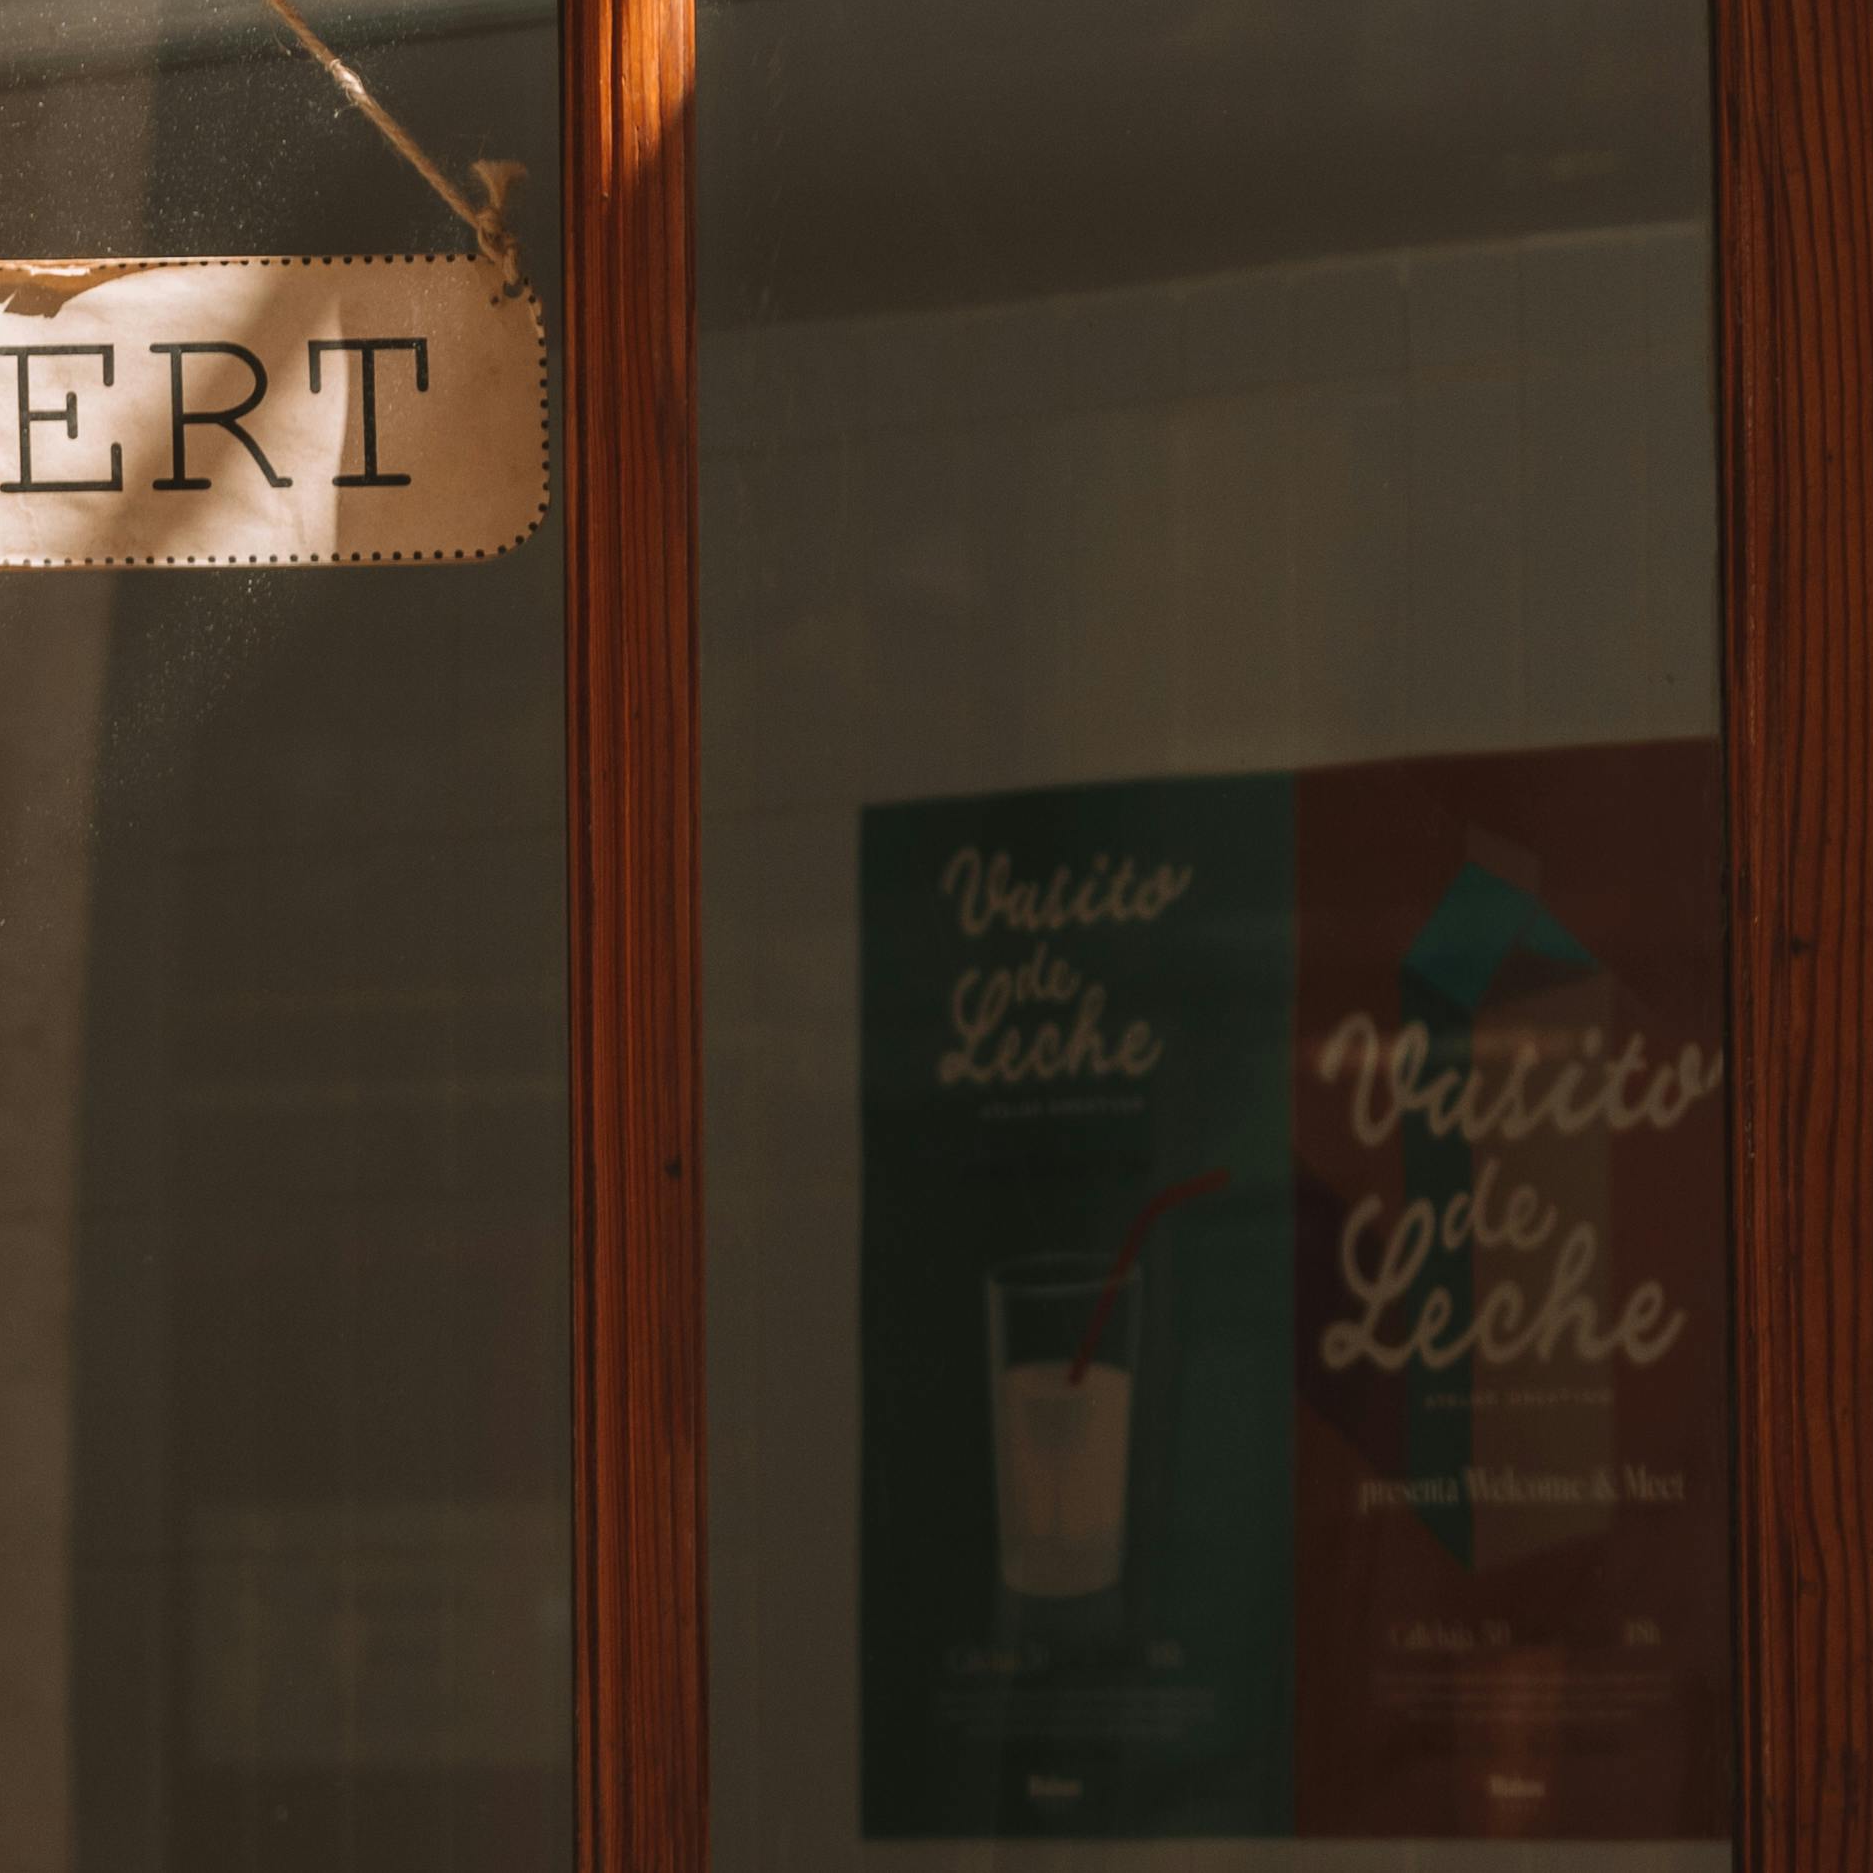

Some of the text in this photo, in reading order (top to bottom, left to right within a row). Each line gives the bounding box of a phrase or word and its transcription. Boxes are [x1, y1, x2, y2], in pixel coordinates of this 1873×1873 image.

[943, 846, 1194, 937] Vasito
[1014, 940, 1082, 1003] de
[935, 967, 1164, 1084] Leche
[1316, 1012, 1724, 1147] Vasito
[1439, 1155, 1559, 1252] de
[1318, 1192, 1690, 1374] Leche
[1358, 1463, 1687, 1517] presenta Welcome & Meet
